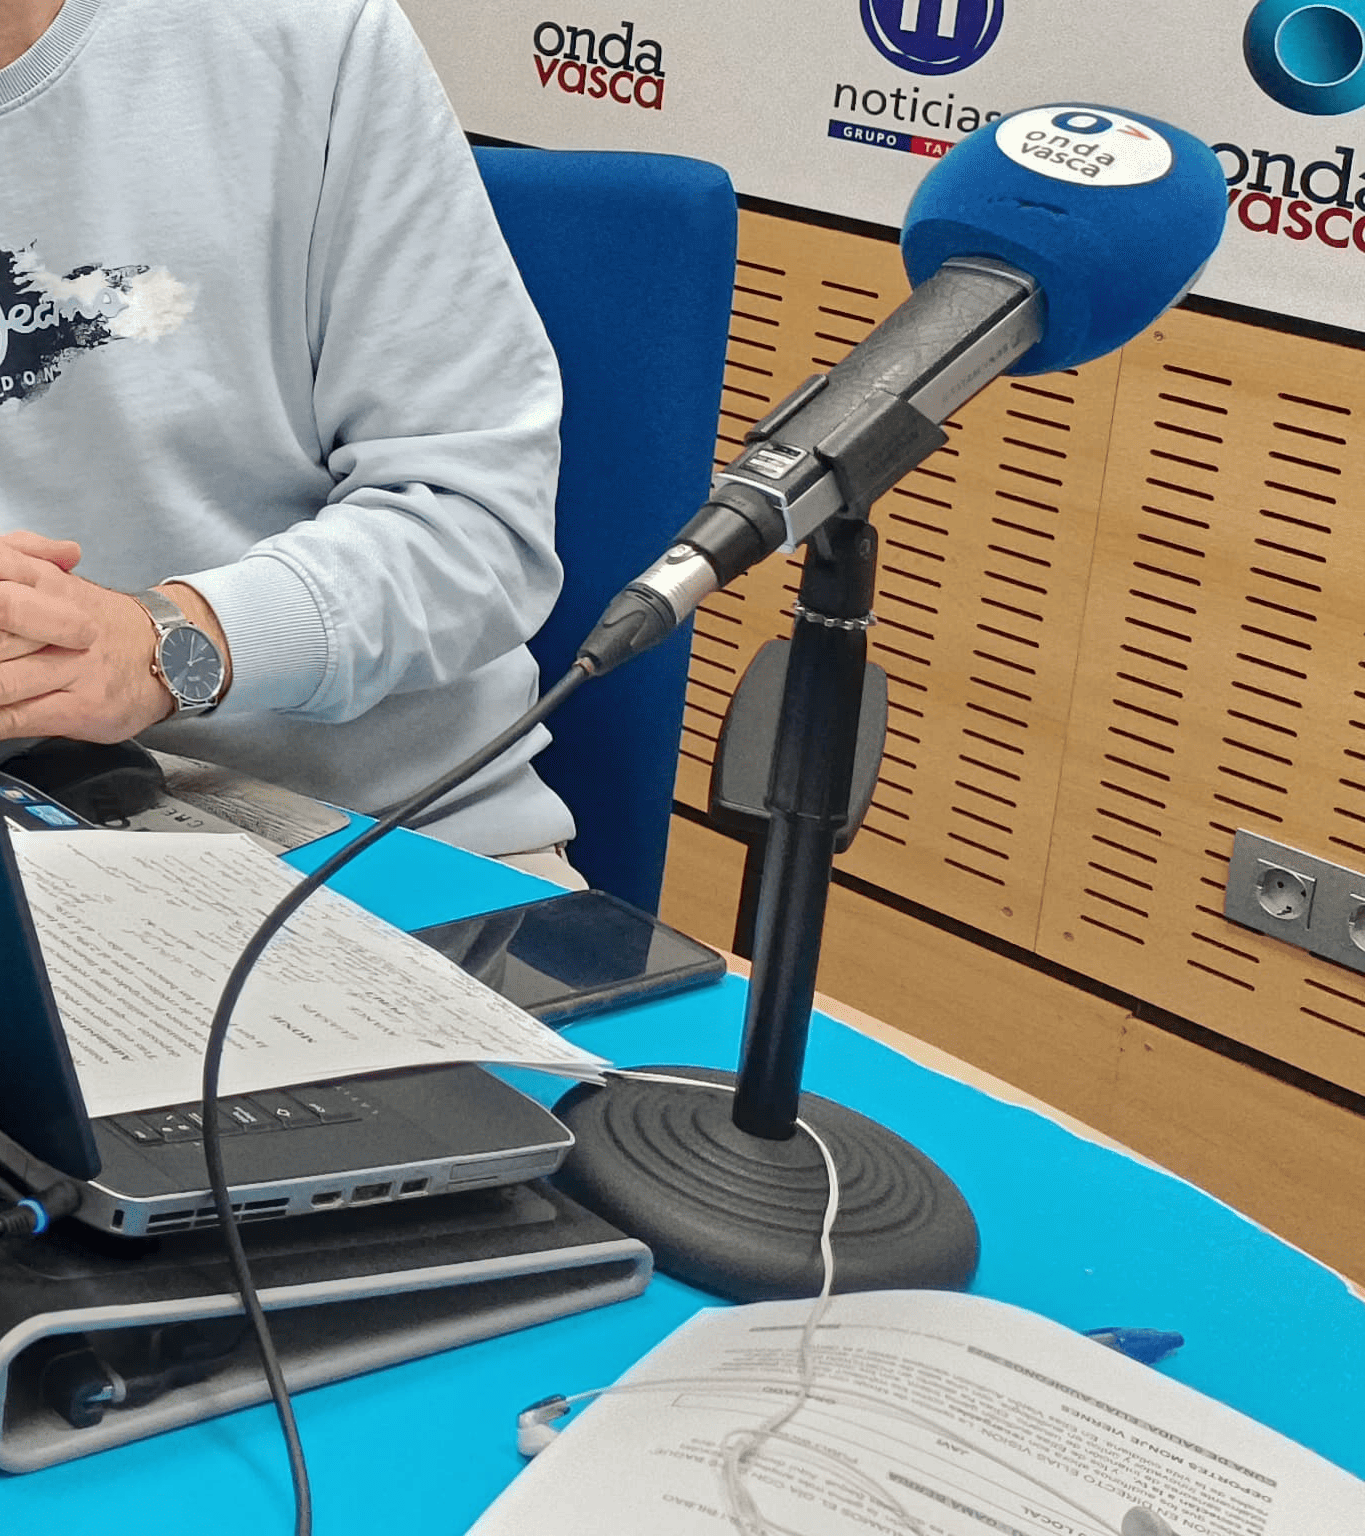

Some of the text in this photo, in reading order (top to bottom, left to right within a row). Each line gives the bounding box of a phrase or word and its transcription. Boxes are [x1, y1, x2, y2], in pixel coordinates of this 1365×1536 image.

[533, 21, 666, 77] onda
[534, 55, 665, 110] vasca
[843, 125, 898, 147] GRUPO
[1025, 128, 1116, 167] onda
[1019, 140, 1102, 179] vasca
[1228, 188, 1365, 253] asc
[1129, 1433, 1183, 1465] MONJE
